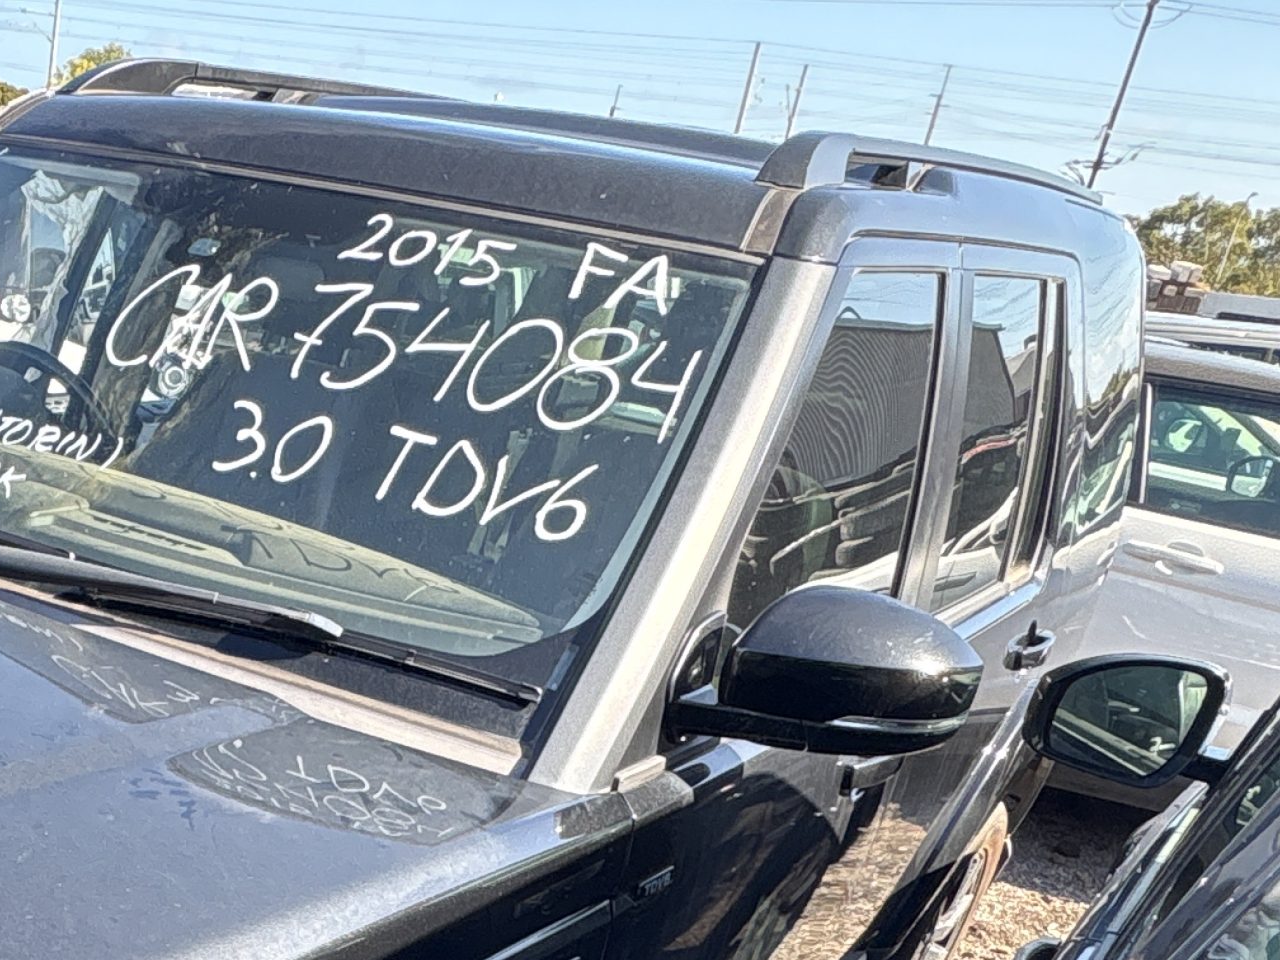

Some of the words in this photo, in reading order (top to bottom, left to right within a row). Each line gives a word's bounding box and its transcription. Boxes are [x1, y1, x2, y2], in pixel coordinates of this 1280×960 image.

[337, 214, 516, 285] 2015
[568, 243, 671, 314] FA
[105, 265, 280, 371] CAR
[290, 282, 703, 443] 754084
[212, 400, 333, 482] 3.0
[375, 425, 600, 541] TDV6
